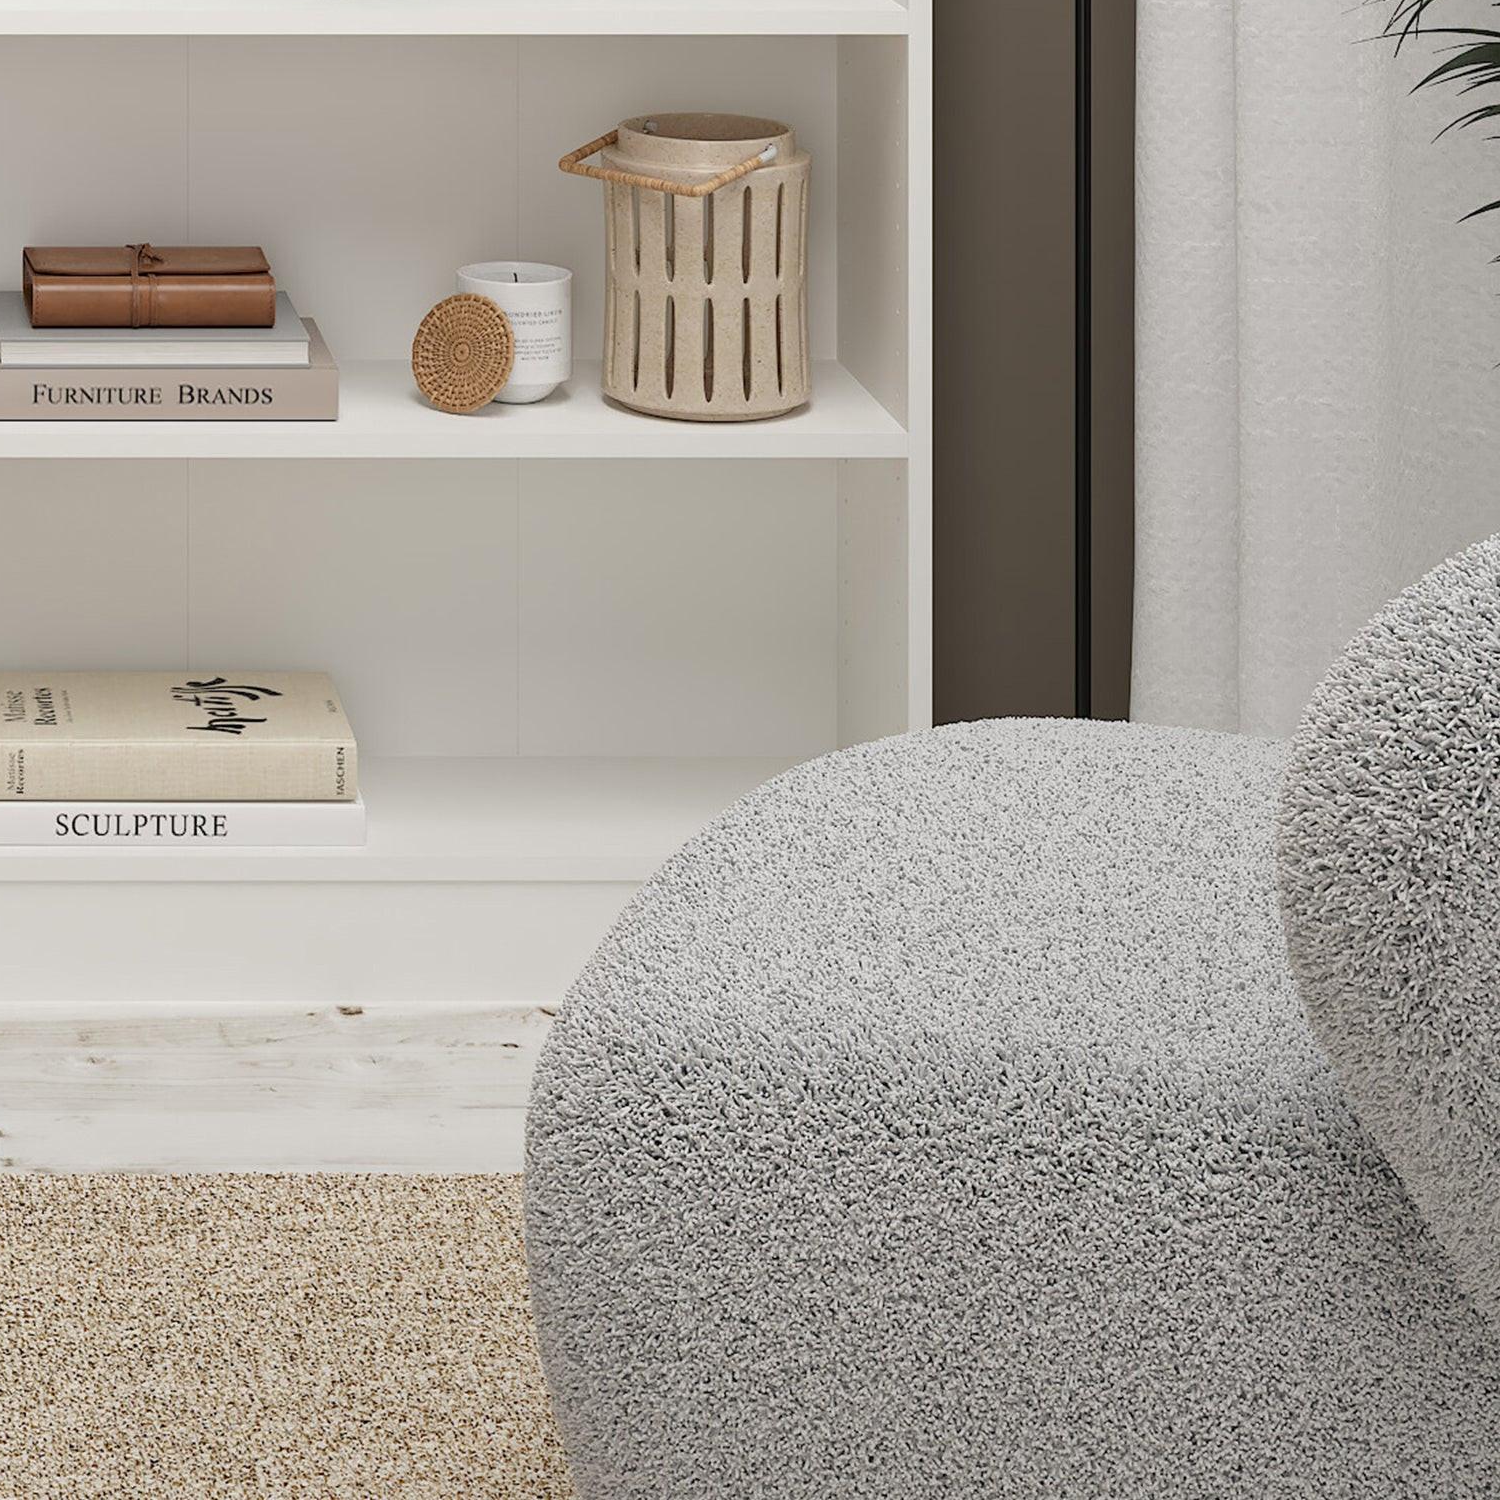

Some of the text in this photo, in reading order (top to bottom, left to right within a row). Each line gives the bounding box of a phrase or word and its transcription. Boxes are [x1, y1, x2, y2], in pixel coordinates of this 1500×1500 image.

[32, 384, 274, 405] FURNITURE BRANDS
[1, 690, 26, 723] Matisse
[32, 687, 58, 726] Recortes
[335, 746, 346, 796] TASCHEN
[55, 813, 229, 839] SCULPTURE
